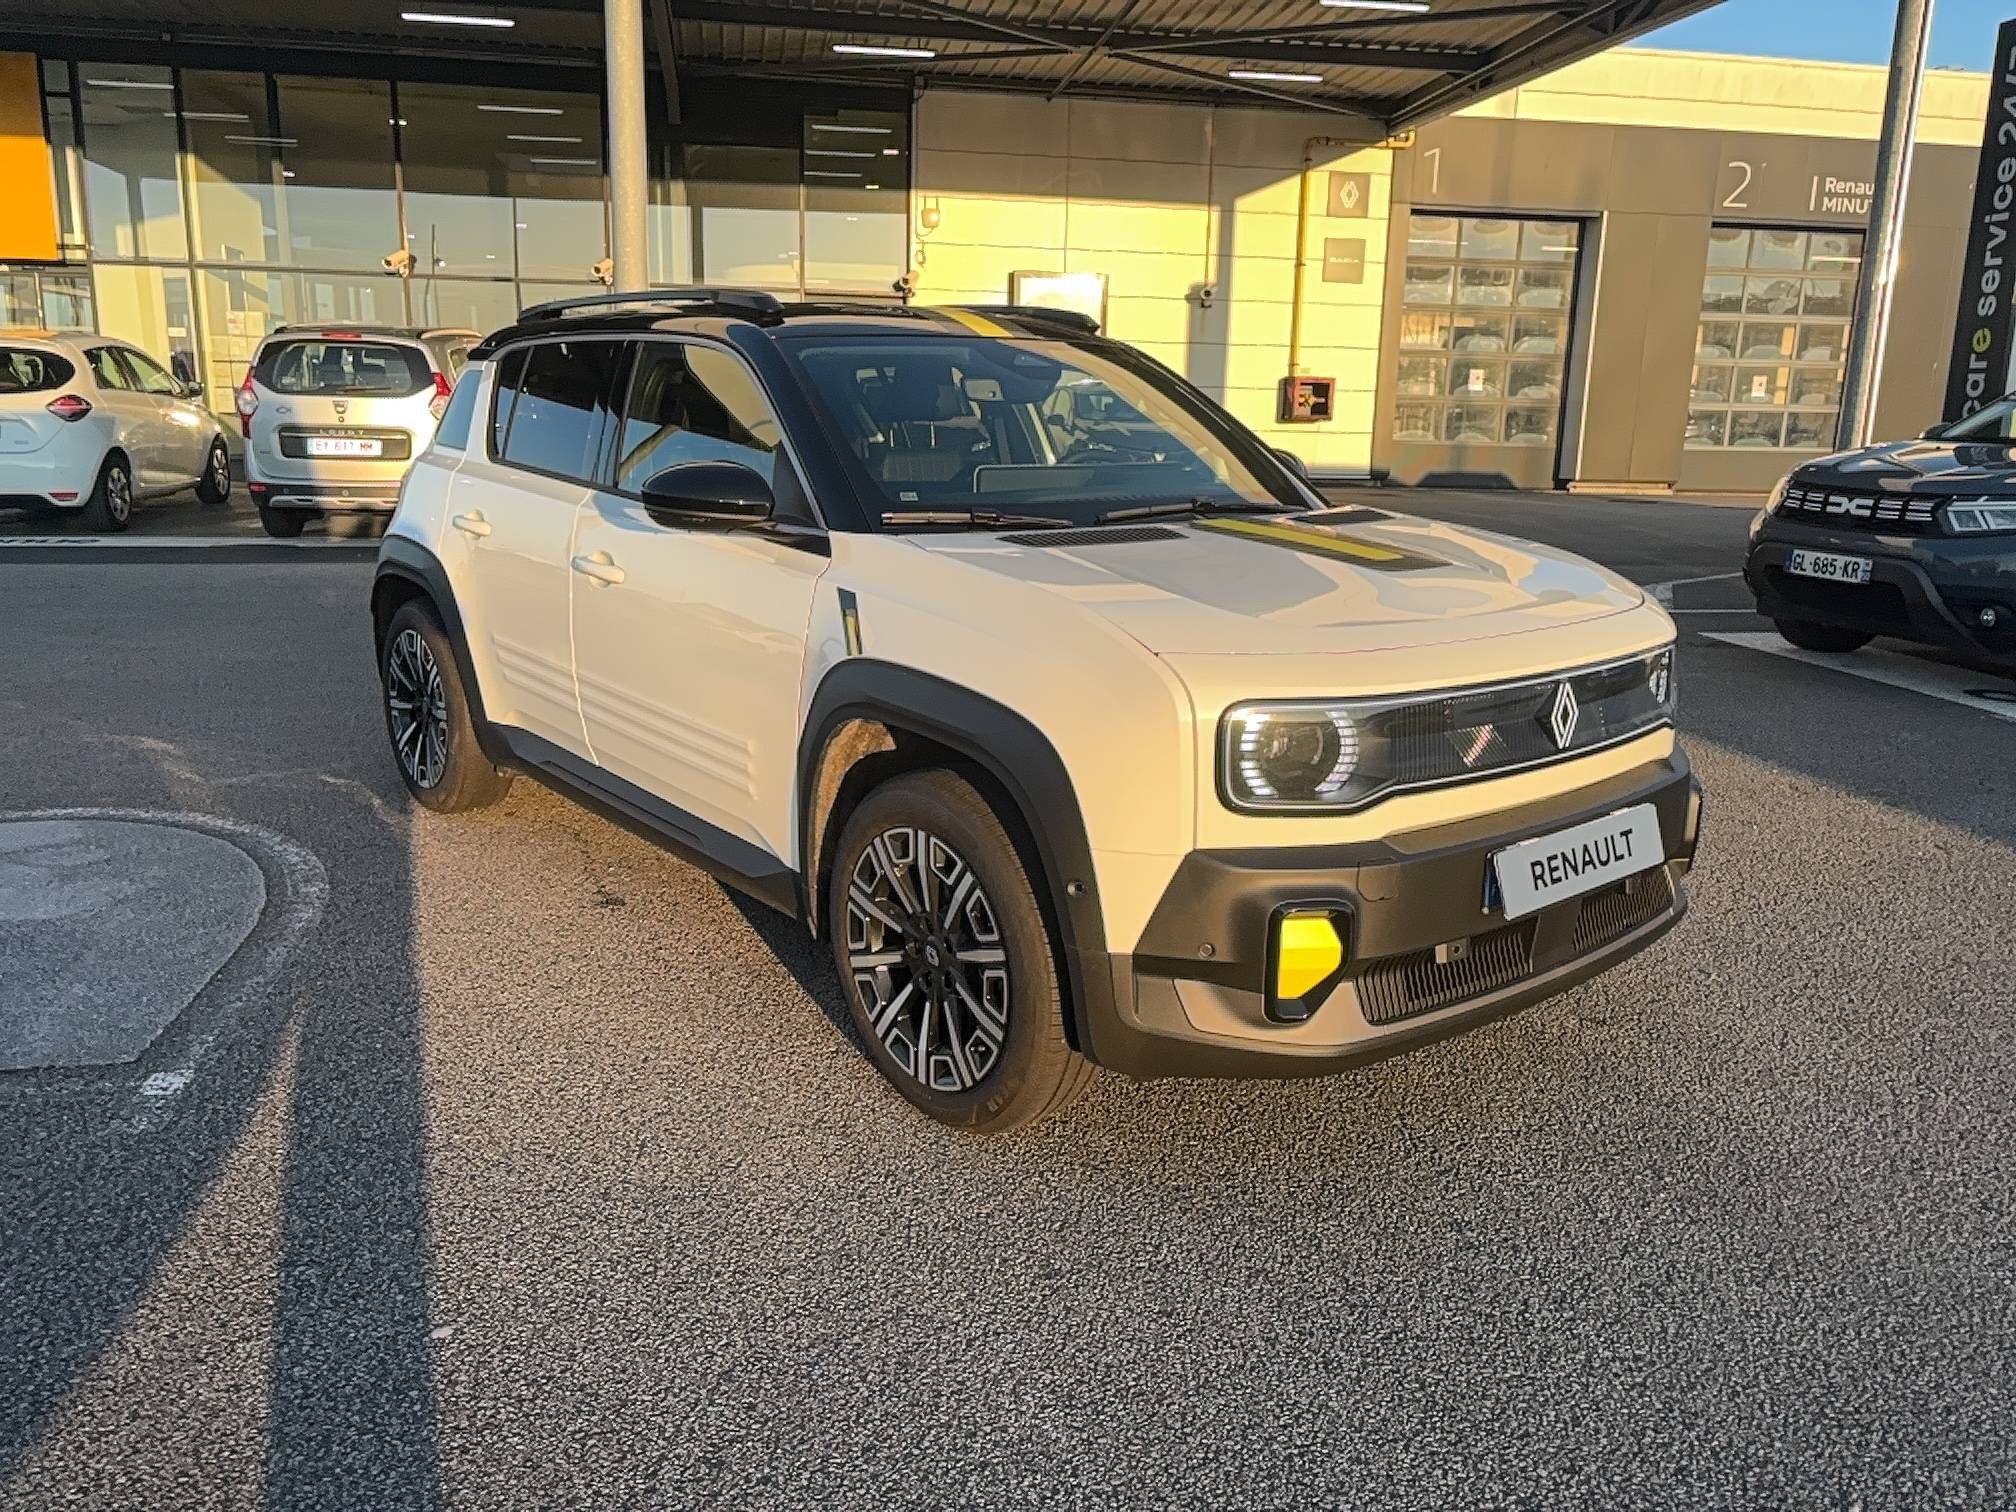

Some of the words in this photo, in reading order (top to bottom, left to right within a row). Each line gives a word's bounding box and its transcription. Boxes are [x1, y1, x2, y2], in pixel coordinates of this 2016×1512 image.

[1423, 147, 1440, 195] 1
[1722, 161, 1752, 208] 2
[1961, 327, 1992, 418] care
[1977, 157, 2016, 317] service
[1530, 828, 1633, 891] RENAULT
